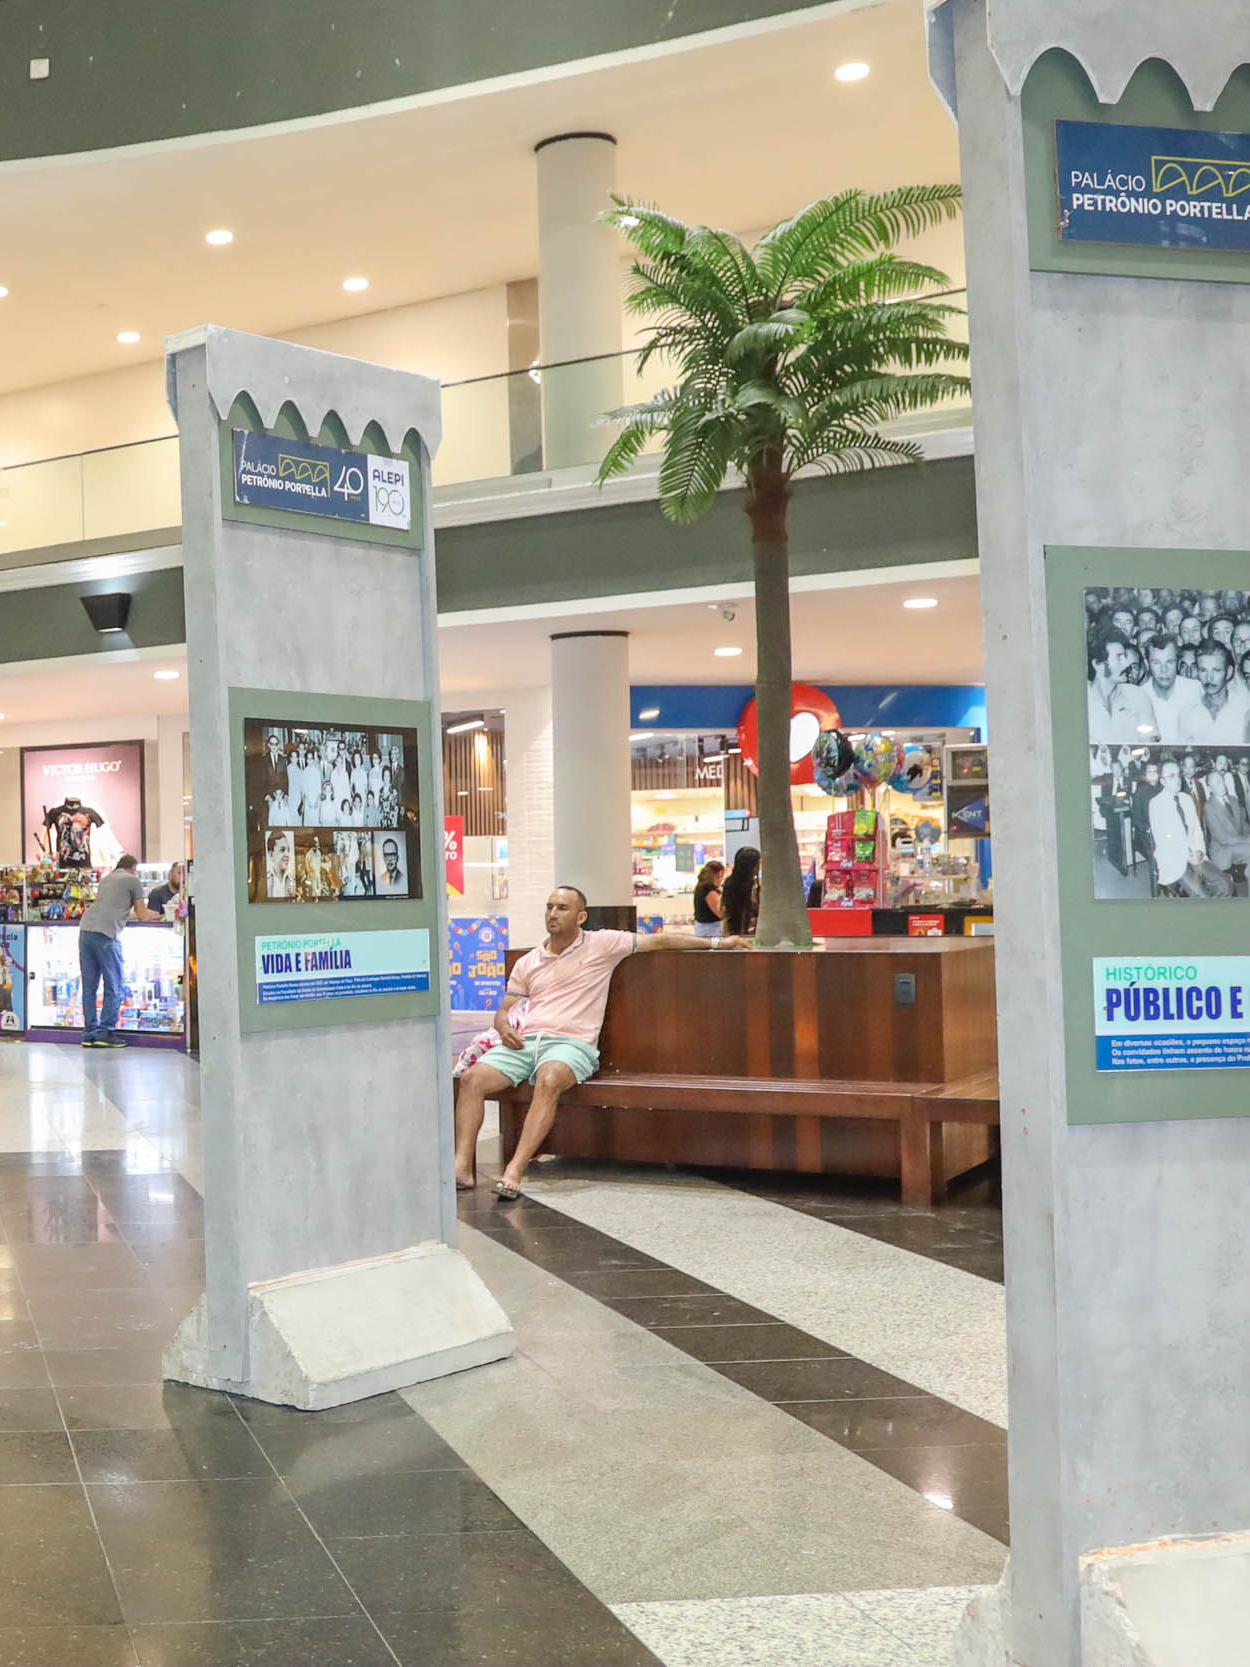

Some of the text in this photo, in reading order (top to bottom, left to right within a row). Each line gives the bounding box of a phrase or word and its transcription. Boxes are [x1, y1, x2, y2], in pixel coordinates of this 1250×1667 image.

[1071, 168, 1146, 192] PALÁCIO
[1072, 192, 1162, 215] PETRÔNIO
[241, 459, 277, 476] PALÁCIO
[372, 468, 405, 487] ALEPI
[241, 473, 328, 498] PETRÔNIO PORTELLA
[333, 465, 364, 501] 40
[42, 760, 121, 776] VICTOR HUGO
[261, 947, 352, 974] VIDA E FAMÍLIA
[1105, 963, 1198, 982] HISTÓRICO
[1105, 981, 1244, 1022] PÚBLICO E
